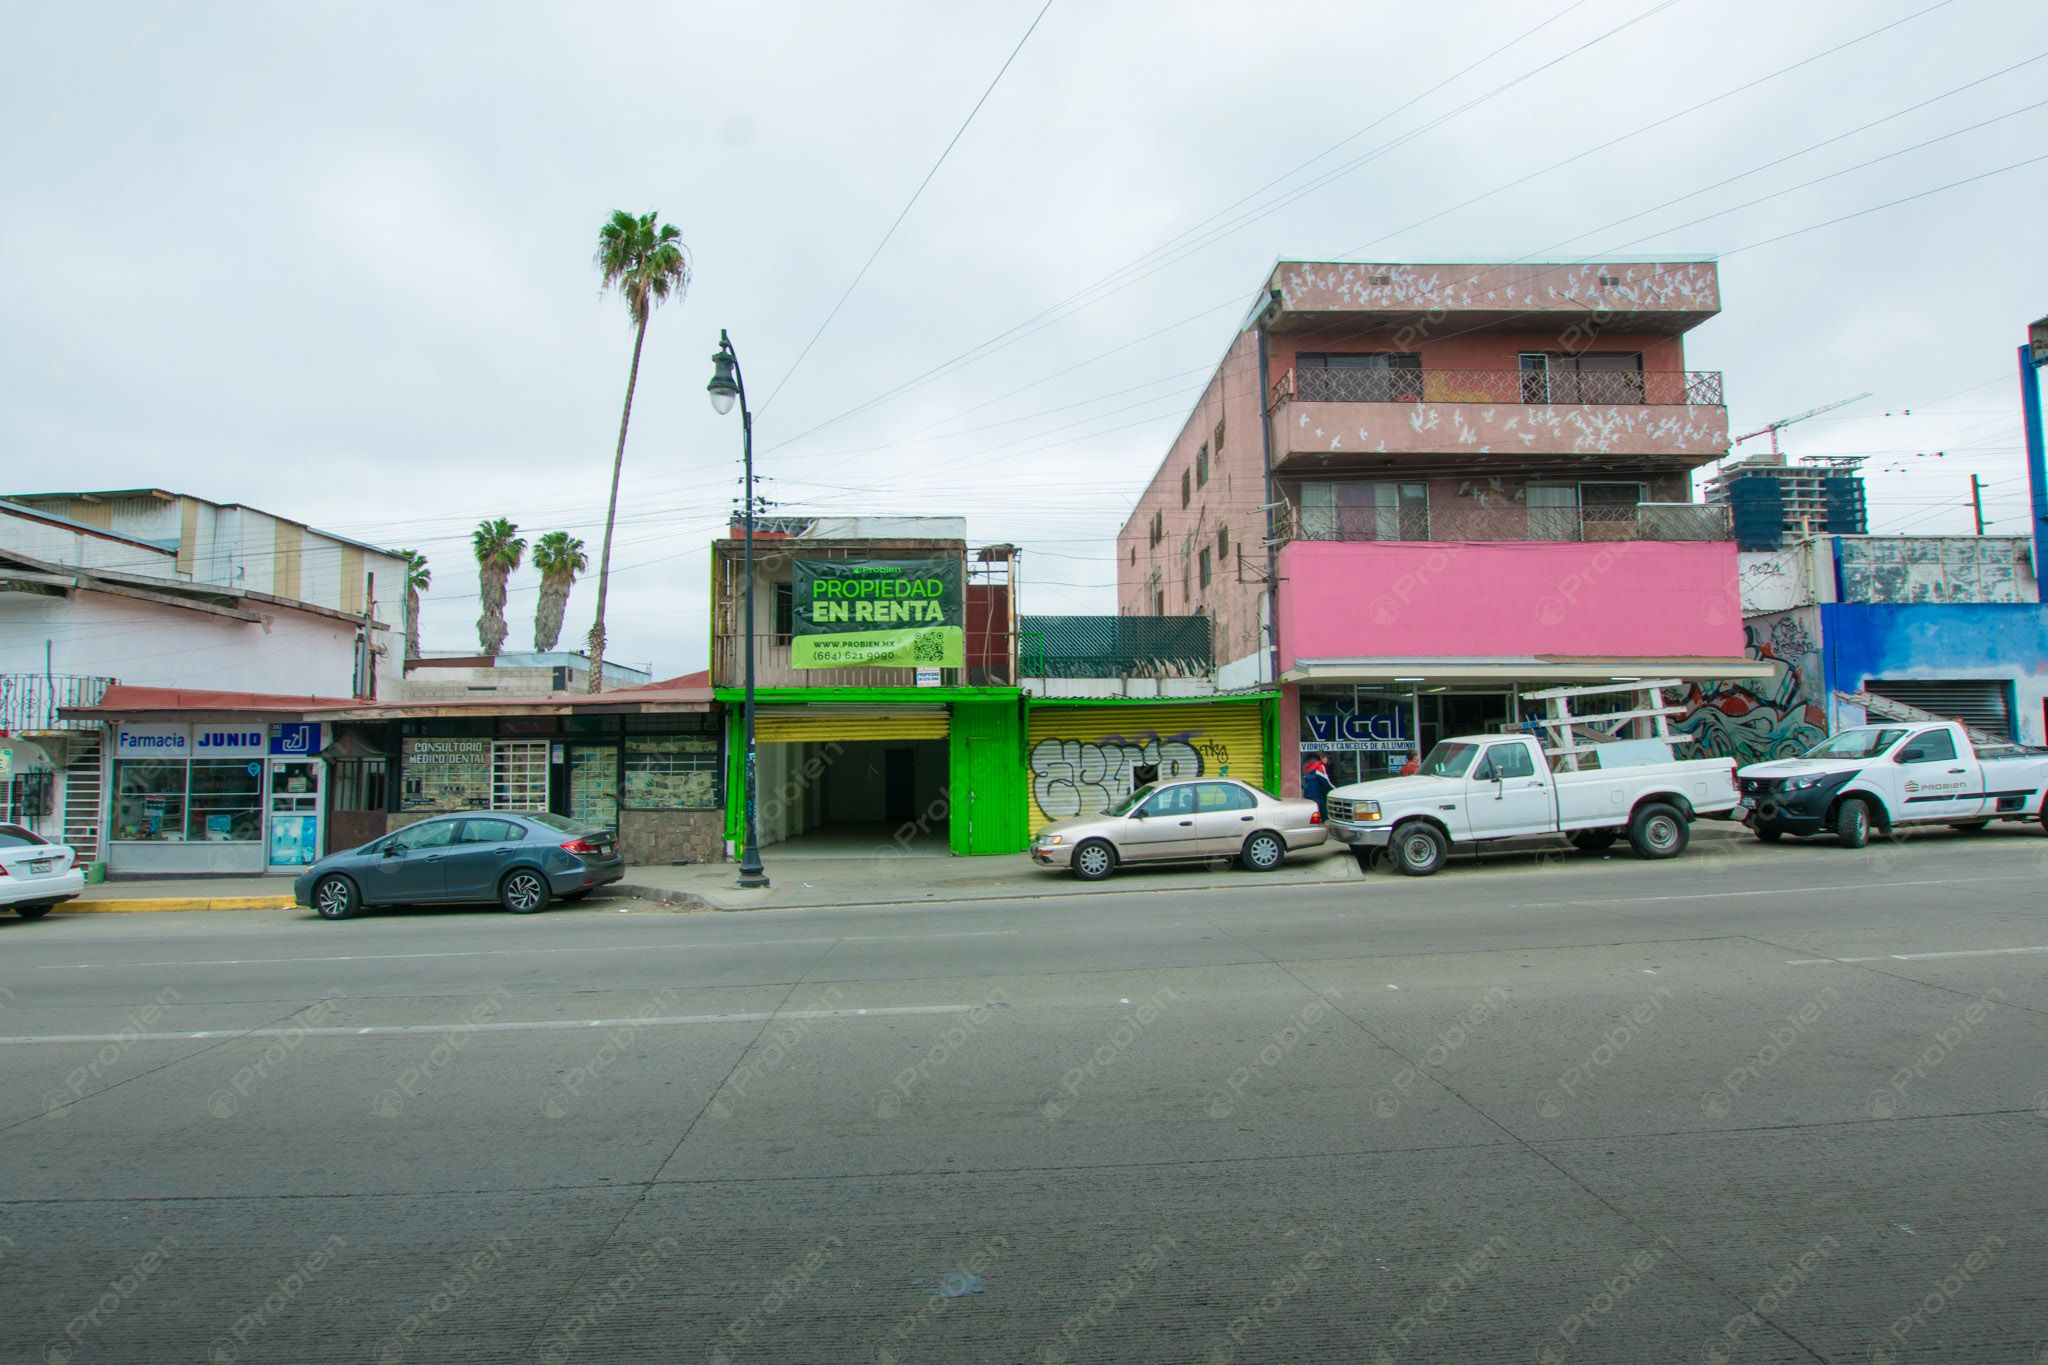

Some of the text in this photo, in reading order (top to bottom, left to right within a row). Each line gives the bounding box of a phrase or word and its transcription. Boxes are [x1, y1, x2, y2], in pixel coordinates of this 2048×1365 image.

[813, 579, 943, 598] PROPIEDAD
[813, 600, 944, 622] EN RENTA
[813, 651, 894, 660] (664) 621 9090
[120, 733, 261, 747] Farmacia JUNIO
[415, 743, 482, 752] CONSULTORIO
[1301, 742, 1329, 750] VIDRIOS
[1336, 742, 1369, 750] CANCELES
[1370, 742, 1377, 750] DE
[409, 754, 484, 763] MEDICO DENTAL
